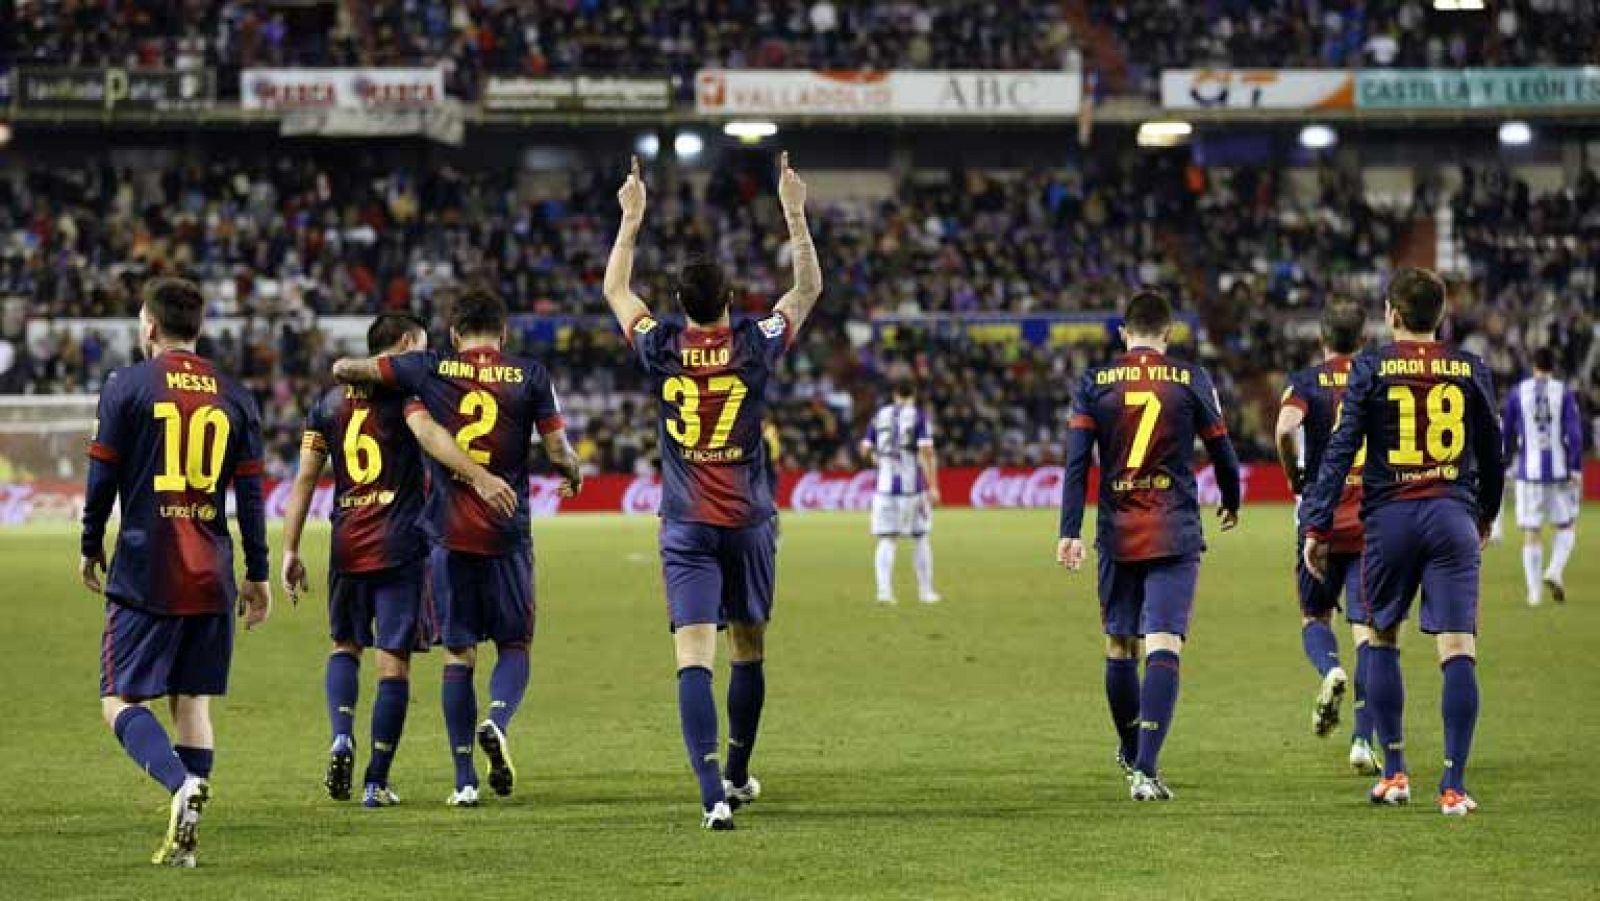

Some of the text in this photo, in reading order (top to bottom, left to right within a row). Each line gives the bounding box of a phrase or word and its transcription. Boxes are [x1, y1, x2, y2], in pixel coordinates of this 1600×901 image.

[733, 82, 891, 109] VALLADOLID
[942, 77, 1040, 107] ABC
[1362, 78, 1469, 102] CASTILLA
[1482, 79, 1498, 101] Y
[1506, 73, 1566, 102] LEÓN
[438, 359, 524, 384] DANI ALVES
[680, 349, 730, 367] TELLO
[1378, 358, 1473, 379] JORDI ALBA
[165, 371, 218, 395] MESSI
[1096, 365, 1191, 385] DAVID VILLA
[662, 375, 748, 449] 37
[1386, 382, 1466, 466] 18
[456, 390, 498, 465] 2
[1124, 391, 1162, 468] 7
[153, 401, 230, 494] 10
[343, 408, 382, 485] 6
[159, 502, 203, 519] unicef
